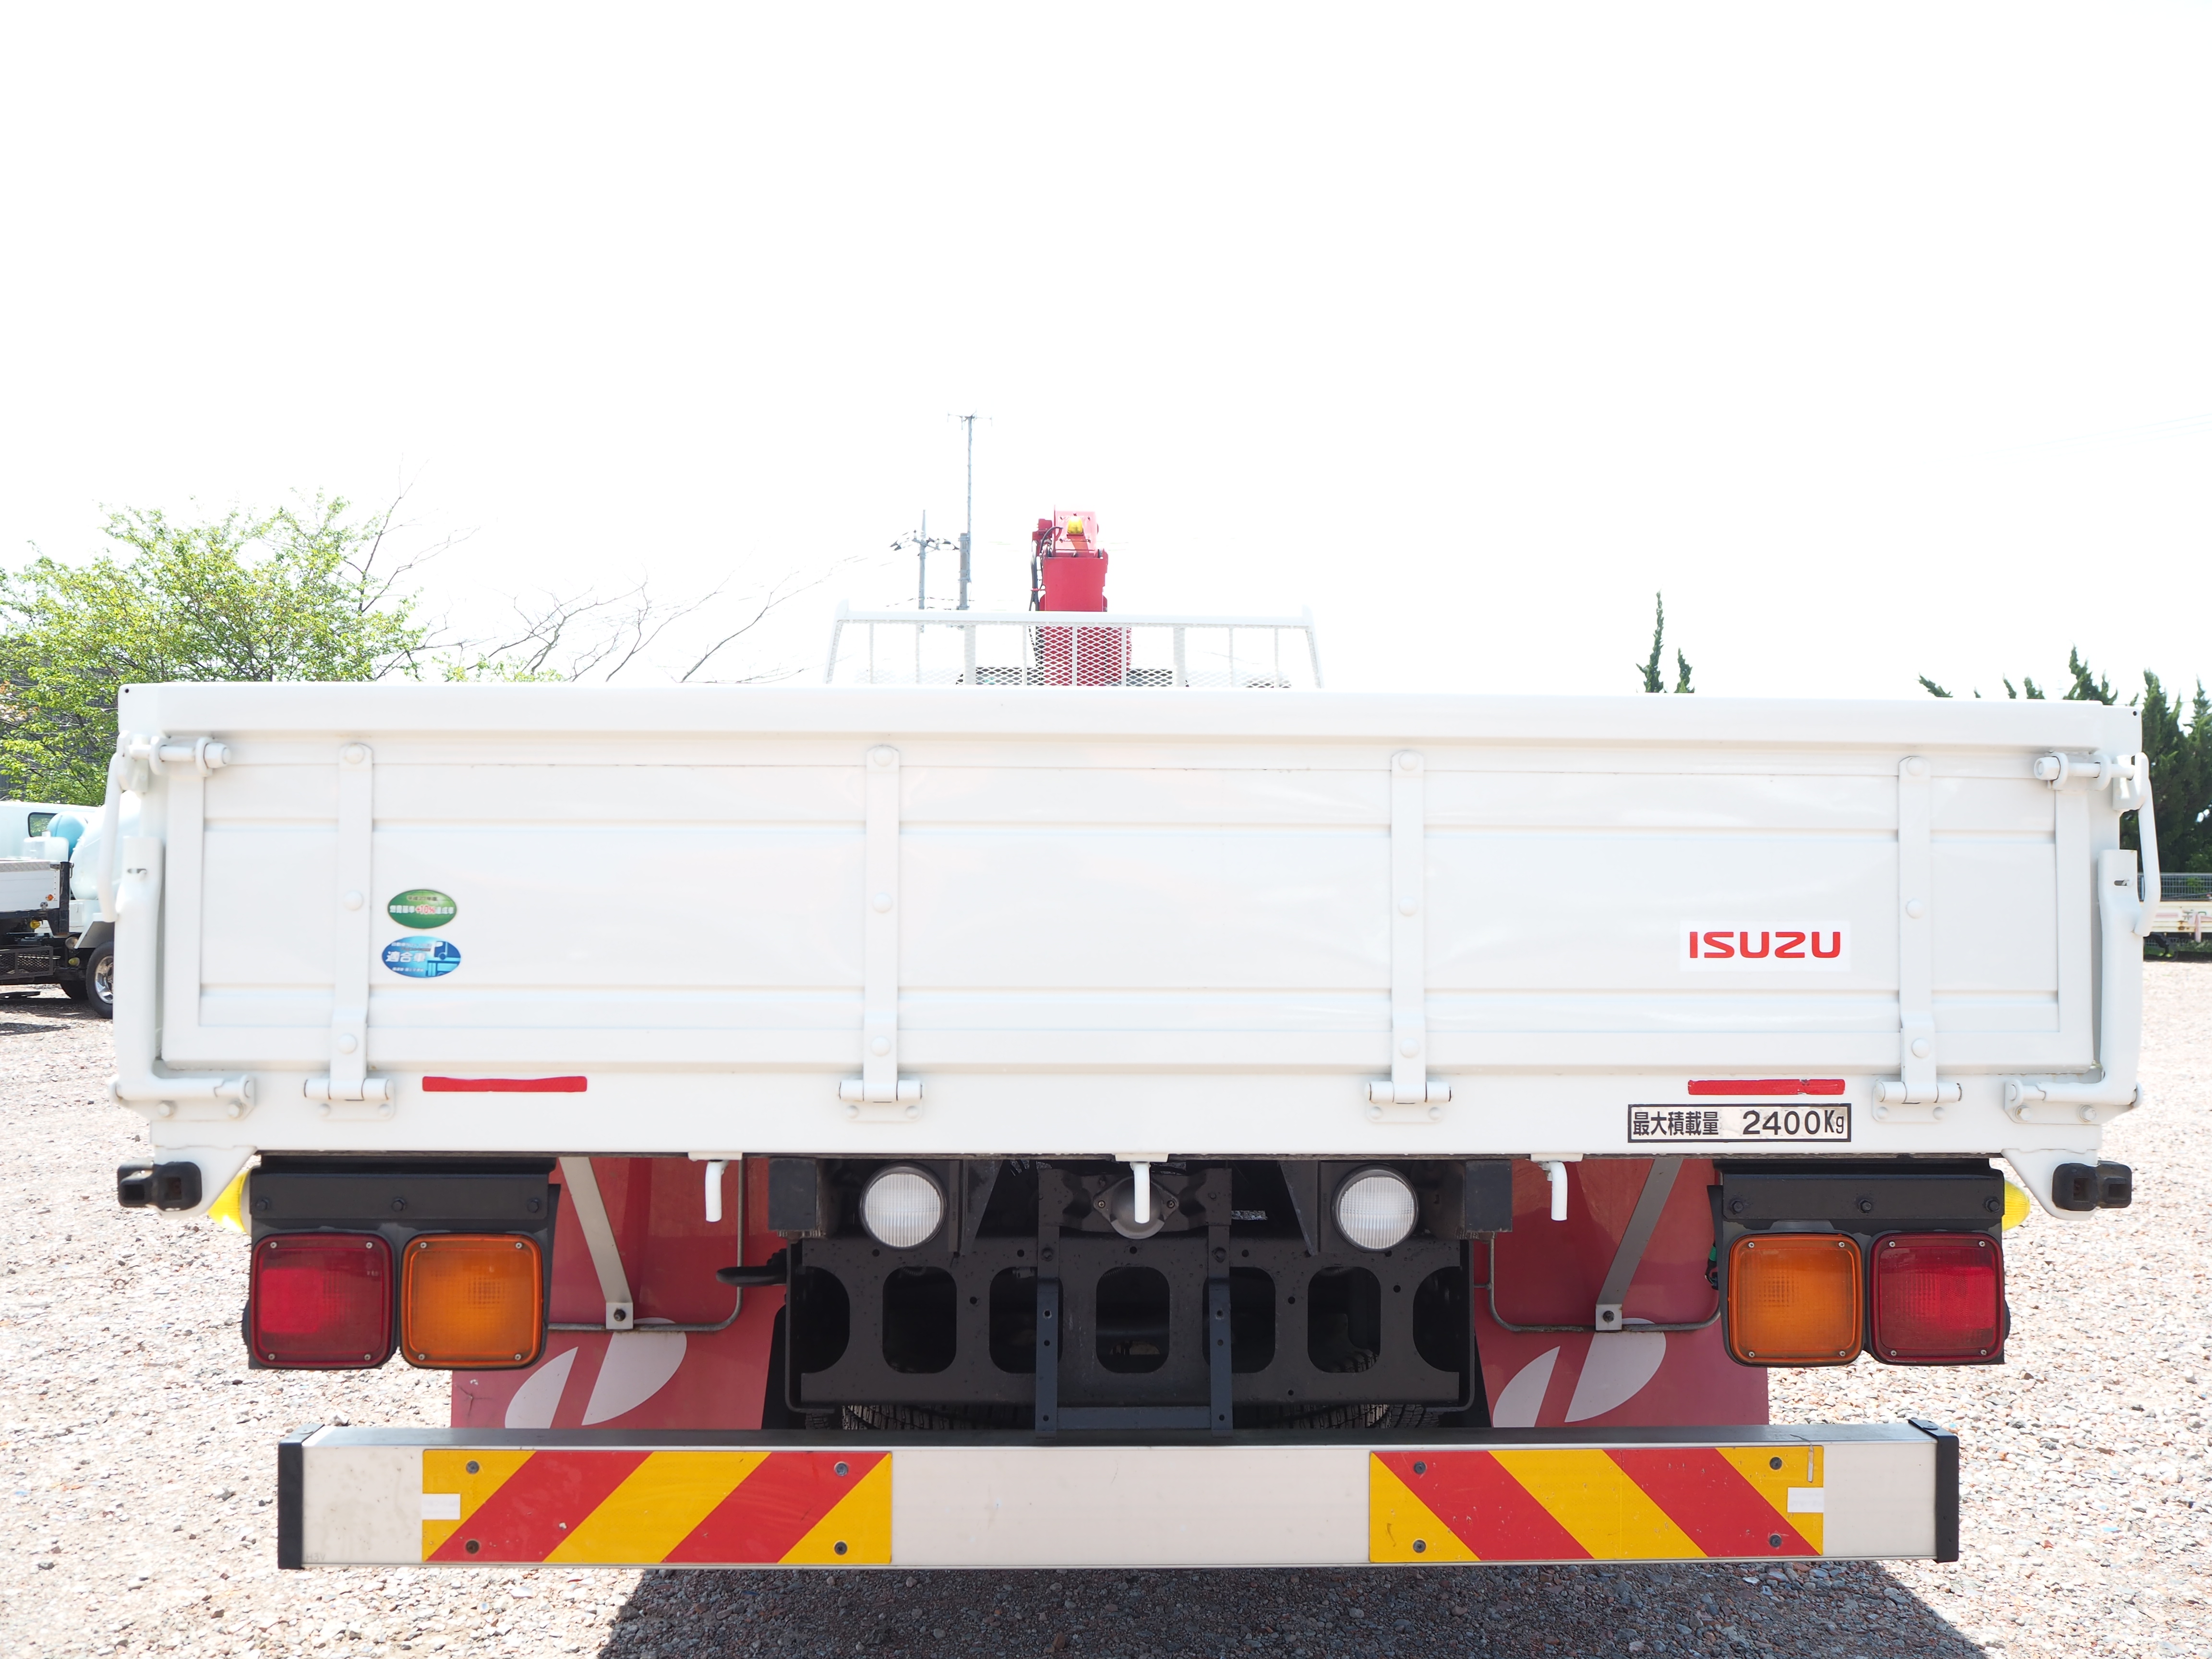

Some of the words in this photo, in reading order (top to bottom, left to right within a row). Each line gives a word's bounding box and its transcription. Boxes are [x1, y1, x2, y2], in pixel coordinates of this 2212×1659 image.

[385, 951, 425, 962] 適合車
[1690, 931, 1840, 958] ISUZU
[1633, 1111, 1719, 1136] 最大積載量
